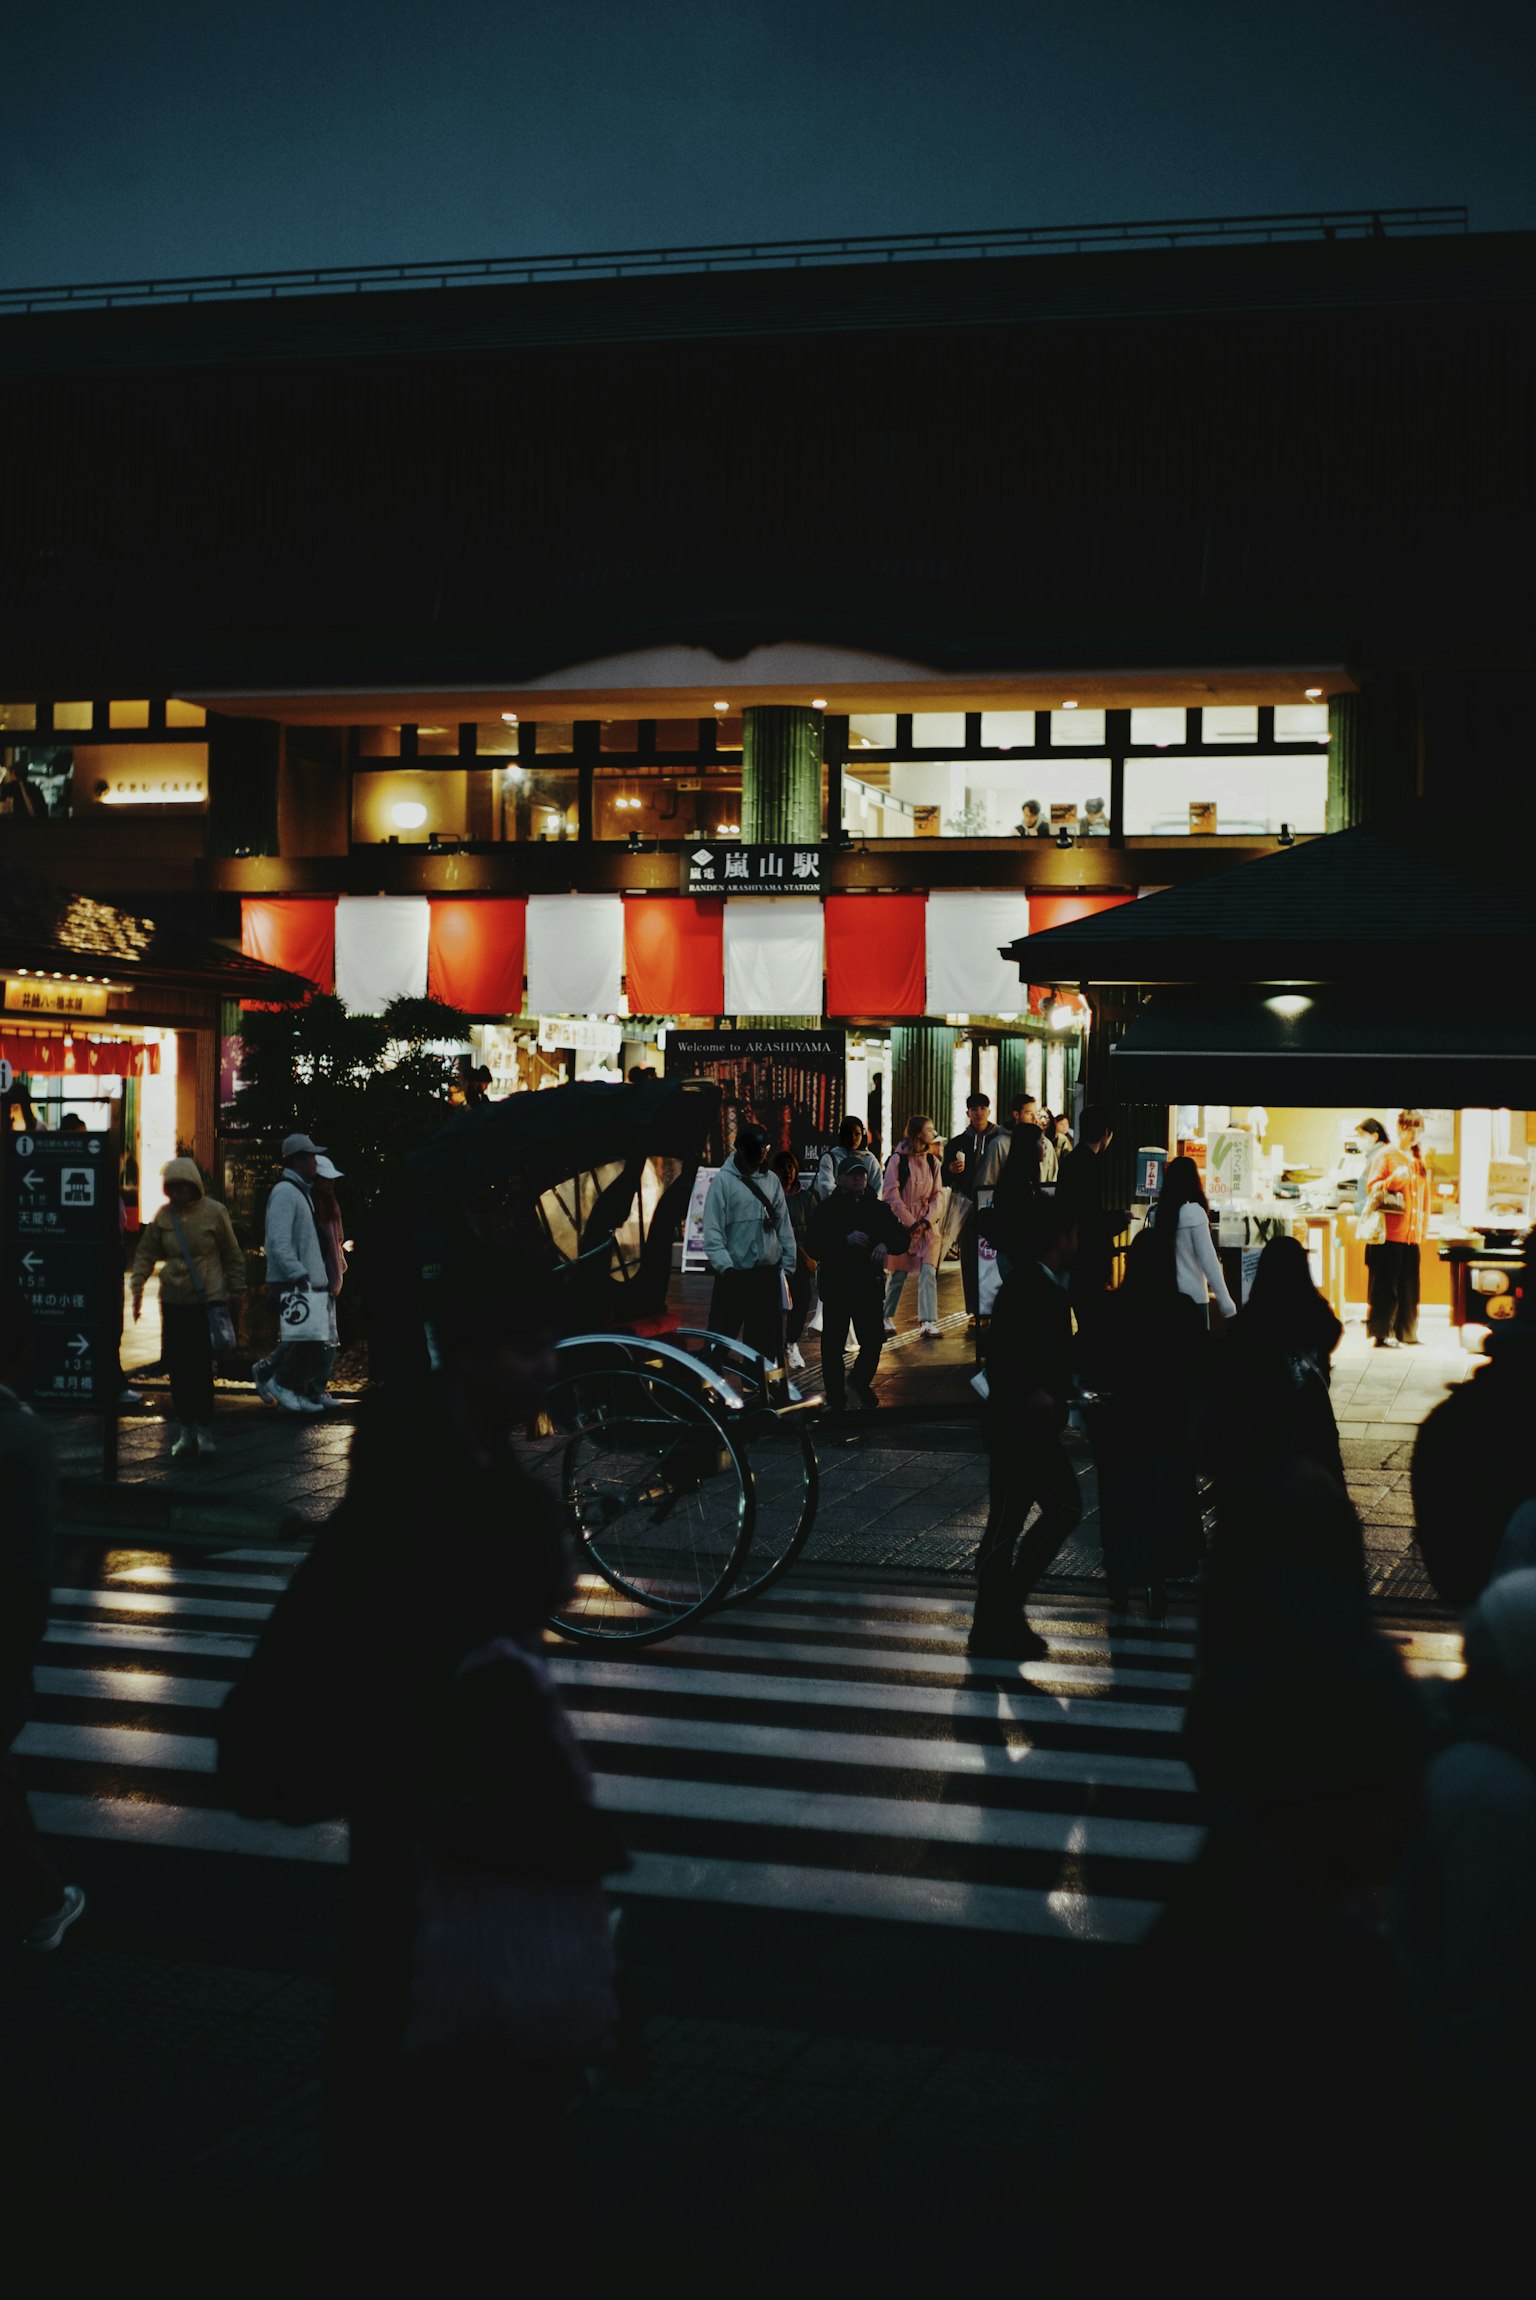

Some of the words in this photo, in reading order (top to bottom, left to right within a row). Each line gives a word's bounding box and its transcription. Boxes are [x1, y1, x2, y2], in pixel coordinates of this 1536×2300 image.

[724, 852, 820, 879] 嵐山駅
[689, 867, 716, 880] 嵐電
[689, 884, 725, 892] RANDEN
[726, 884, 782, 892] ARASHIYAMA
[783, 884, 820, 892] STATION
[677, 1041, 726, 1053] Welcome
[729, 1043, 741, 1053] to
[1148, 1162, 1156, 1187] ラムネ
[18, 1211, 58, 1225] 天龍寺
[28, 1275, 35, 1287] 5
[23, 1292, 85, 1308] 林の小径
[74, 1358, 81, 1370] 3
[53, 1375, 93, 1390] 渡月橋
